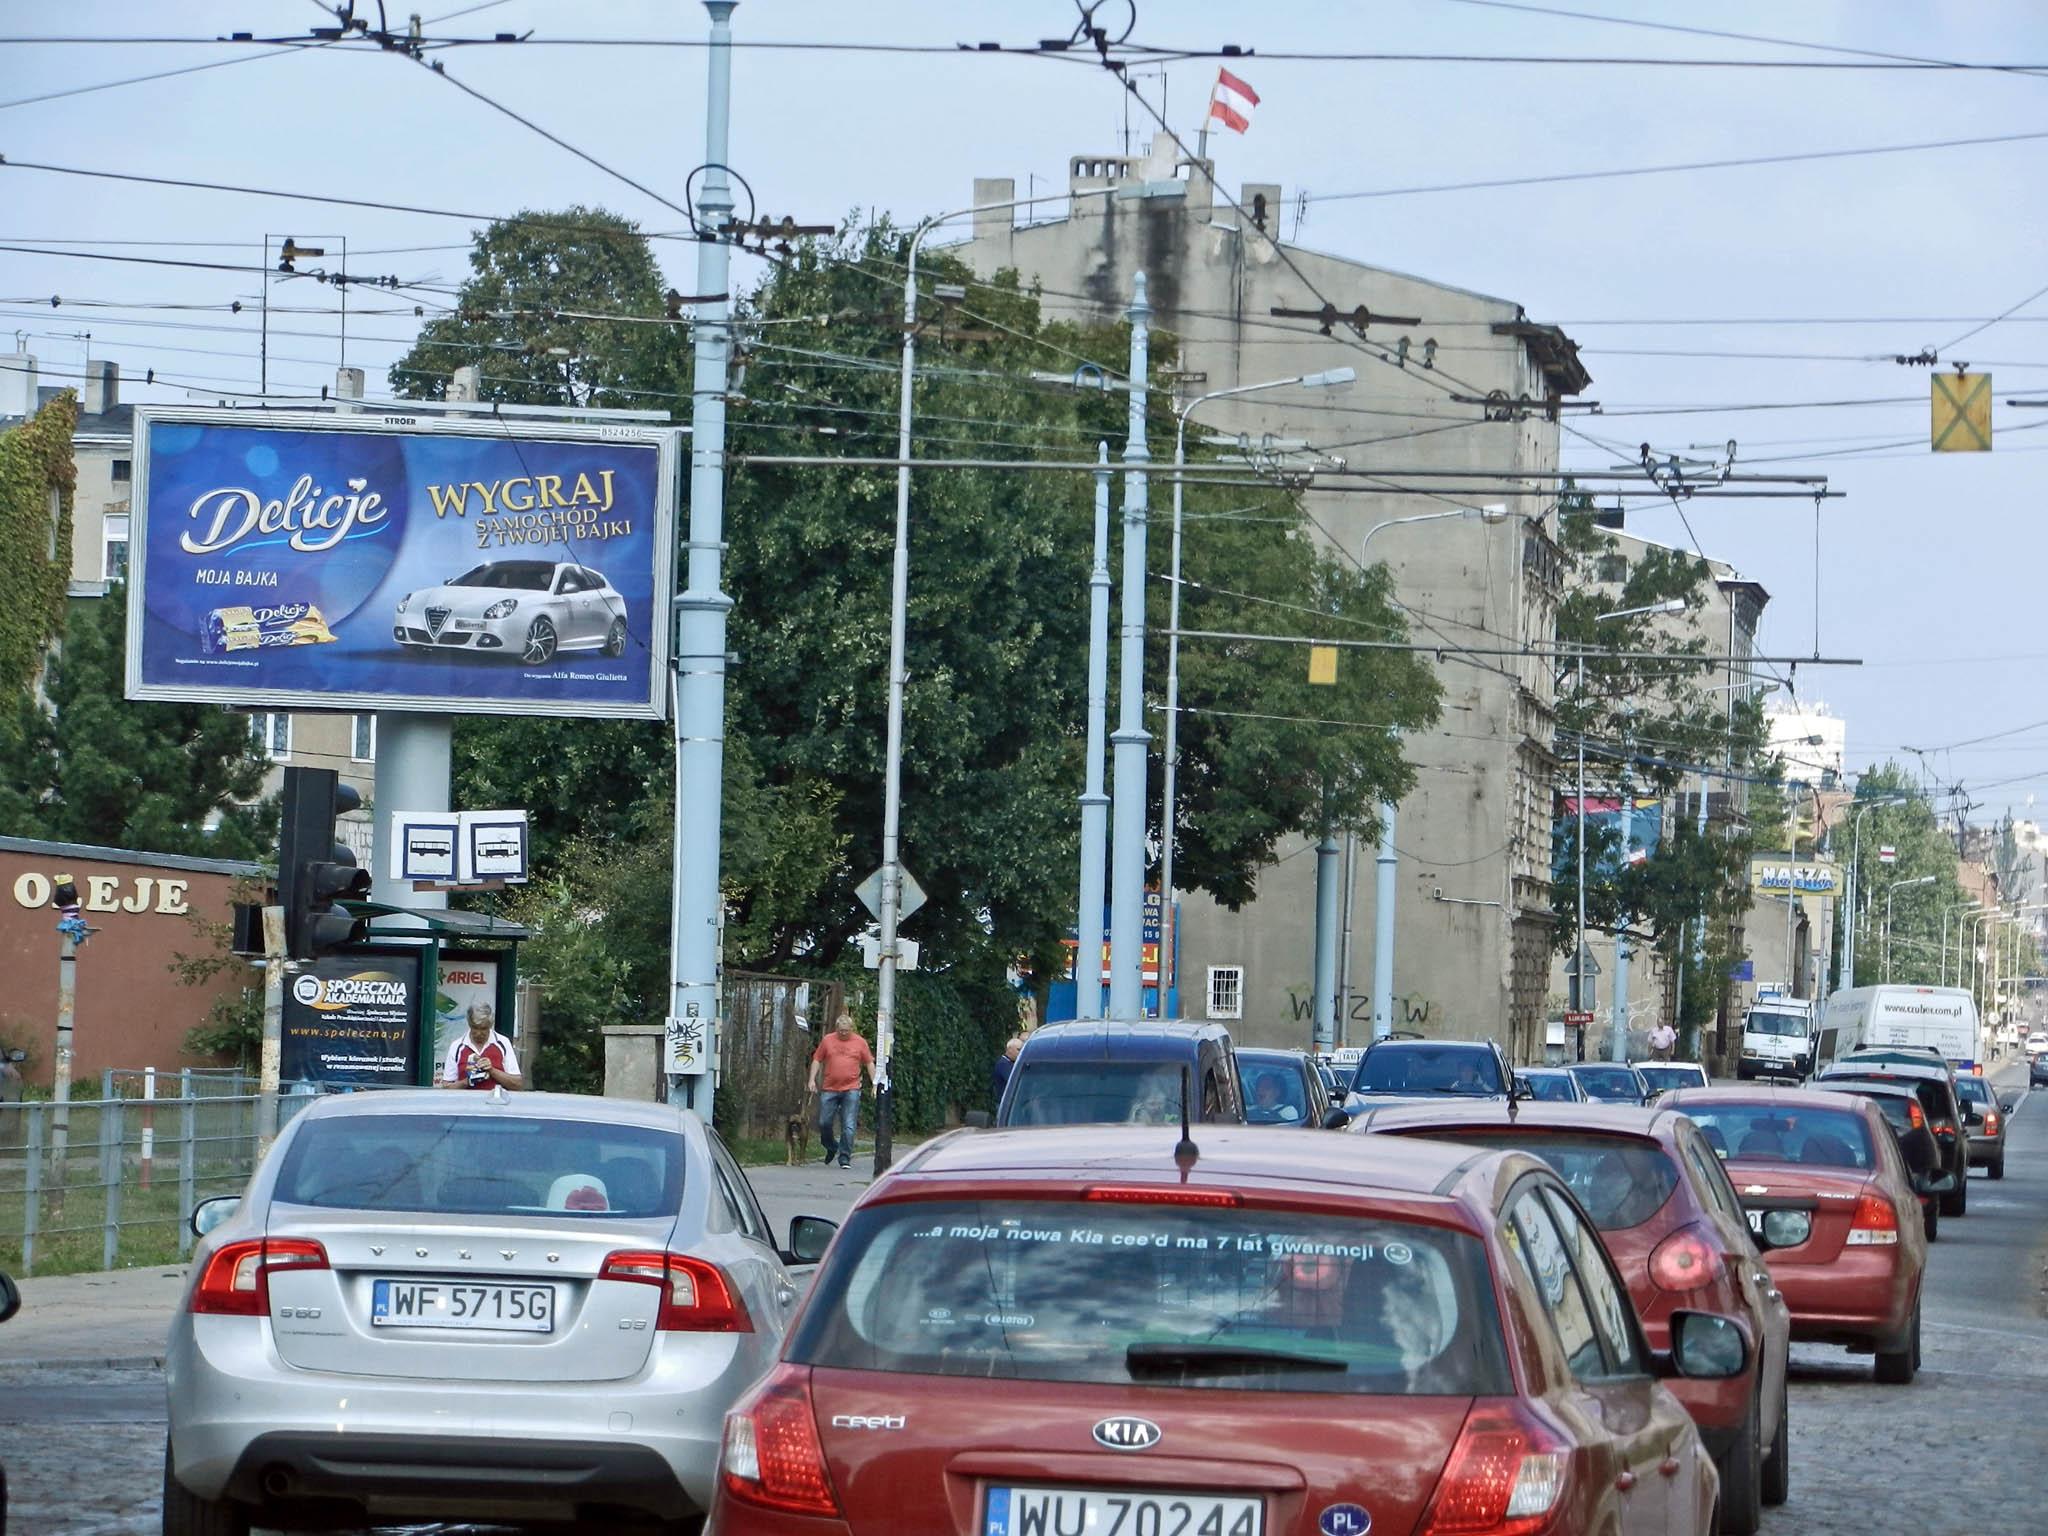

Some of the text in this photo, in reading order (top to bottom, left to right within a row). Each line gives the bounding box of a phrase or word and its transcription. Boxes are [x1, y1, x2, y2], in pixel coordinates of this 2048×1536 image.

[426, 470, 616, 519] WYGRAJ
[180, 472, 388, 554] Delicje
[476, 507, 598, 532] SAMOCHÓD
[476, 519, 632, 549] Z TWOJEJ BAJKI
[195, 569, 279, 587] MOJA BAJKA
[253, 603, 309, 623] Delicje
[552, 671, 569, 679] Alfa
[570, 672, 595, 680] Romeo
[596, 673, 628, 682] Giulietta
[1762, 867, 1833, 882] NASZA
[13, 872, 189, 915] OEJE
[447, 972, 487, 985] ARIEL
[326, 979, 407, 997] SPOŁECZNA
[324, 993, 406, 1006] AKADEMIA NAUK
[290, 1027, 406, 1040] www.spoleczna.pl
[320, 1054, 348, 1063] Wybierz
[950, 1227, 999, 1240] moja
[1006, 1229, 1062, 1243] nowa
[1069, 1230, 1103, 1245] Kia
[1111, 1233, 1169, 1248] cee'd
[1176, 1237, 1208, 1249] ma
[1216, 1237, 1230, 1250] 7
[1237, 1238, 1264, 1252] lat
[1270, 1241, 1374, 1262] gwarancji
[369, 1245, 560, 1263] VOLVO
[376, 1304, 387, 1312] PL
[395, 1286, 547, 1320] WF 5715G
[1103, 1422, 1150, 1443] KIA
[1019, 1495, 1255, 1536] WU 70244
[1333, 1513, 1359, 1530] PL
[990, 1521, 1005, 1534] PL
